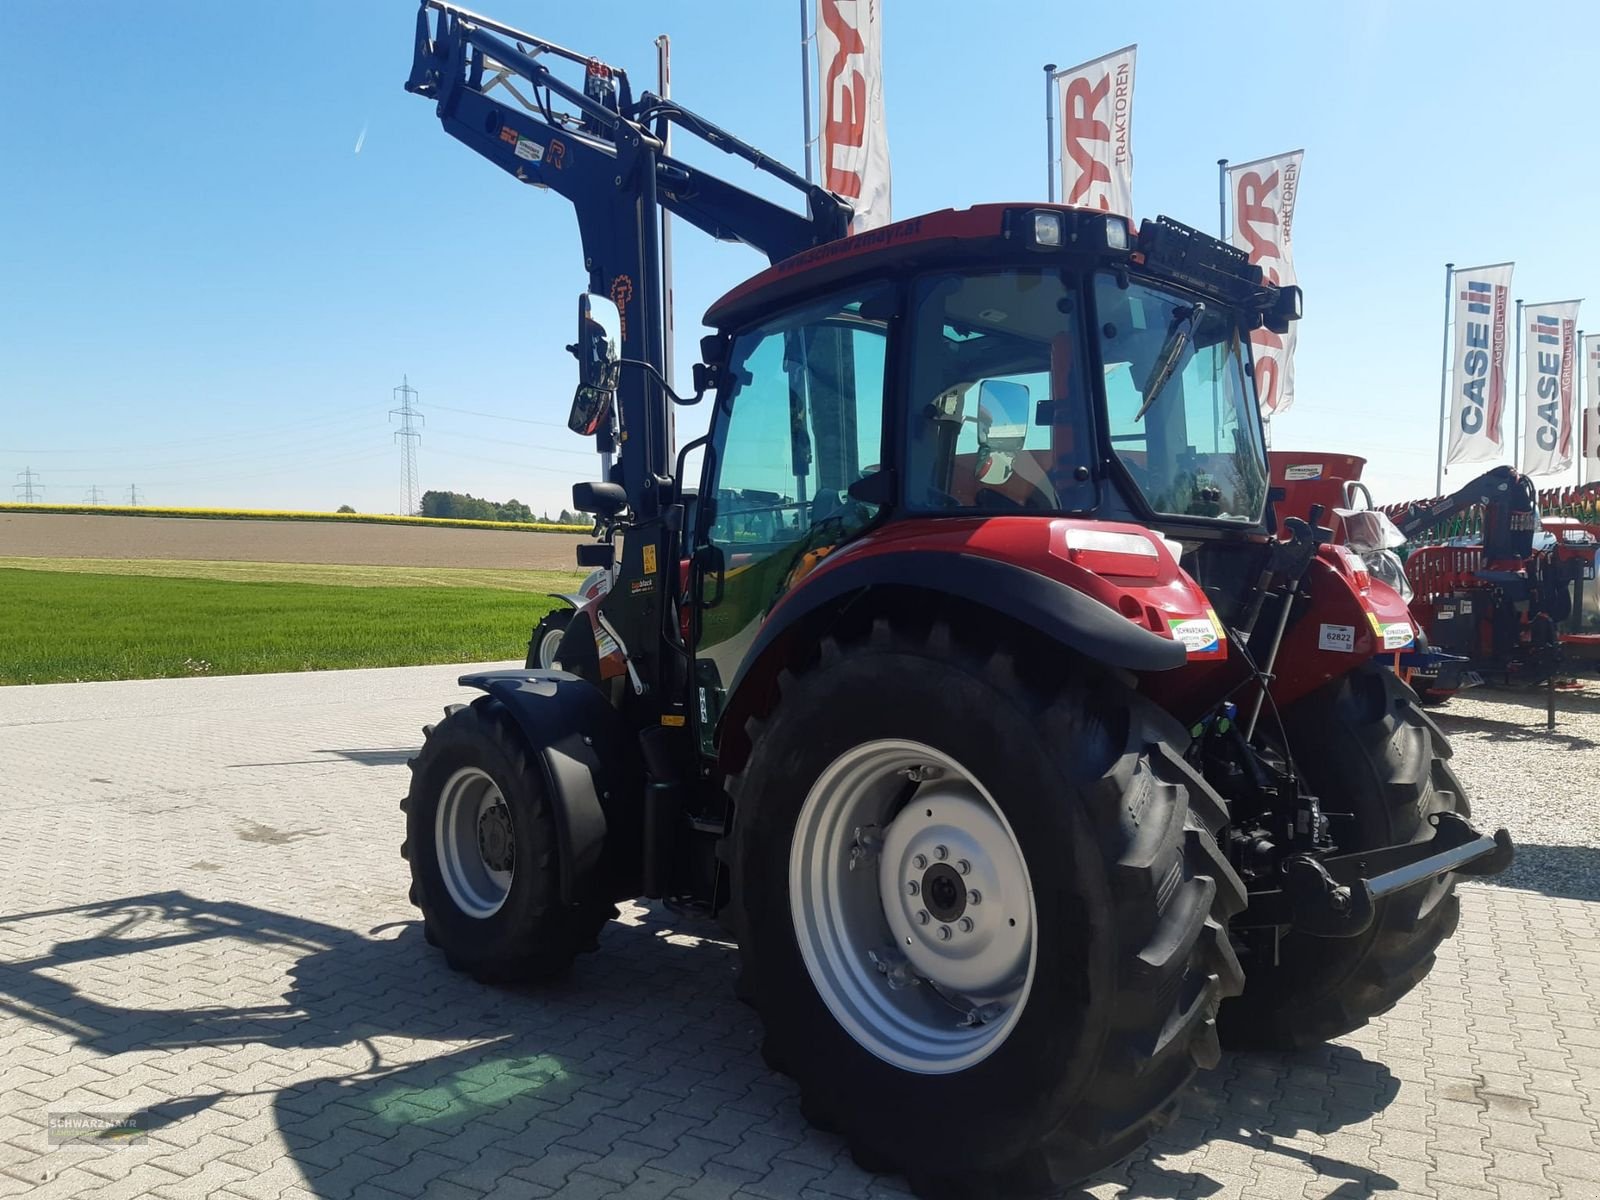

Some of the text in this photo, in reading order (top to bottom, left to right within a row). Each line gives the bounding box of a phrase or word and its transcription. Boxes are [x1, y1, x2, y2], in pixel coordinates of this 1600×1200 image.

[821, 0, 866, 233] TEY
[1115, 63, 1129, 166] TRAKTOREN
[1282, 162, 1297, 245] TRAKTOREN
[1493, 286, 1507, 368] AGRICULTURE
[1562, 320, 1573, 393] AGRICULTURE
[1461, 321, 1491, 434] CASE
[1536, 351, 1560, 452] CASE
[1326, 632, 1351, 642] 62822
